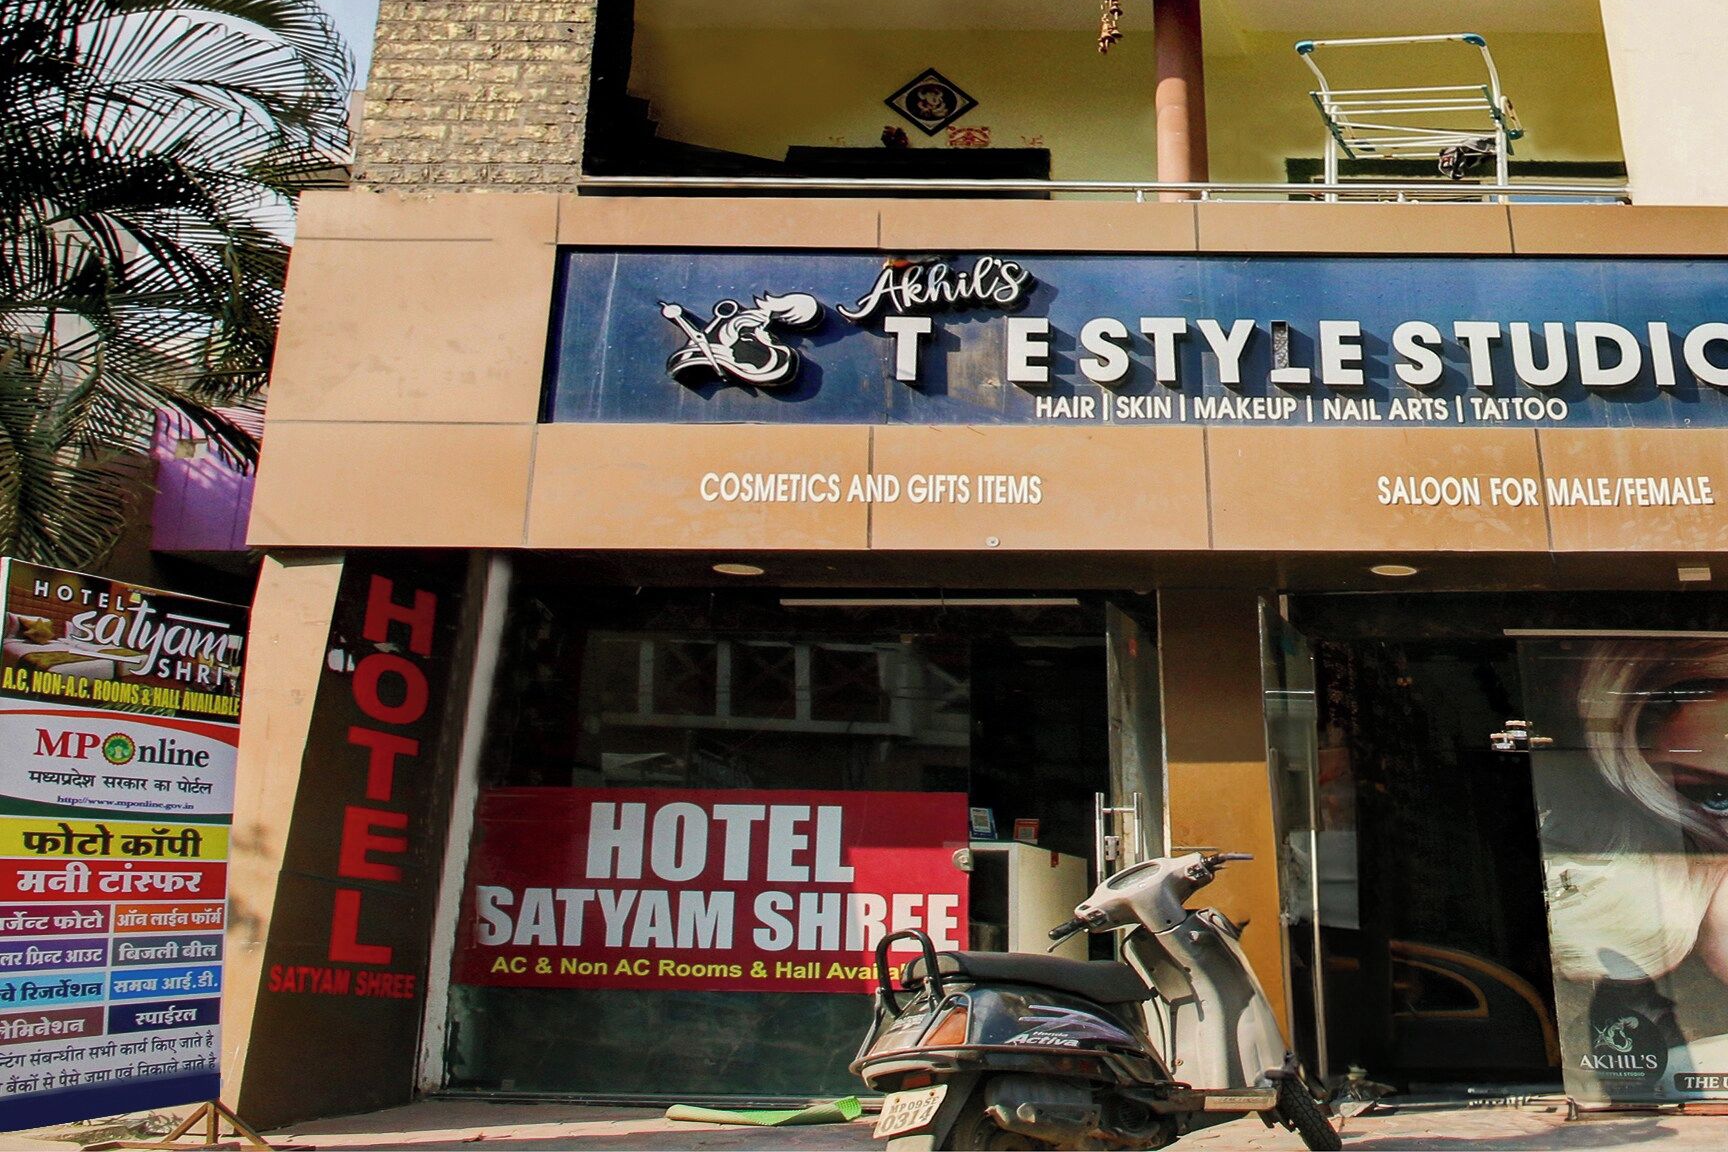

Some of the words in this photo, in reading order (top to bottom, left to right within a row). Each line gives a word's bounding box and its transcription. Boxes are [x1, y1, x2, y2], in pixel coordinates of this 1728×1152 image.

[837, 256, 1029, 319] Akhil's
[1035, 396, 1095, 420] HAIR
[1115, 396, 1172, 420] SKIN
[1192, 397, 1298, 422] MAKEUP
[1323, 397, 1382, 422] NAIL
[1388, 397, 1449, 422] ARTS
[1470, 397, 1569, 422] TATTOO
[700, 472, 840, 504] COSMETICS
[846, 474, 900, 505] AND
[907, 474, 971, 505] GIFTS
[977, 474, 1042, 505] ITEMS
[1377, 476, 1482, 507] SALOON
[1490, 476, 1537, 507] FOR
[1546, 476, 1714, 507] MALE/FEMALE
[34, 580, 125, 612] HOTEL
[71, 599, 229, 676] satyam
[157, 658, 224, 686] SHRI
[93, 679, 139, 705] ROOMS
[141, 688, 151, 706] &
[153, 687, 181, 710] HALL
[181, 690, 240, 716] AVAILABLE
[28, 768, 96, 788] मध्यप्रदेश
[102, 775, 148, 791] सरकार
[154, 779, 172, 792] का
[176, 776, 213, 795] पोर्टल
[328, 573, 438, 966] HOTEL
[22, 822, 114, 855] फोटो
[121, 827, 203, 857] कॉपी
[585, 801, 855, 884] HOTEL
[16, 861, 92, 893] मनी
[54, 909, 104, 929] फोटो
[117, 909, 148, 927] ऑन
[150, 908, 189, 927] लाईन
[191, 907, 223, 925] फॉर्म
[475, 885, 735, 951] SATYAM
[752, 890, 960, 954] SHREE
[0, 952, 23, 966] लर
[25, 945, 62, 966] प्रिन्ट
[65, 948, 104, 963] आउट
[118, 941, 179, 961] बिजली
[182, 940, 218, 958] बील
[268, 963, 350, 995] SATYAM
[354, 969, 416, 1000] SHREE
[491, 956, 531, 975] AC
[534, 957, 552, 975] &
[559, 957, 608, 977] Non
[614, 958, 651, 977] AC
[658, 959, 742, 979] Rooms
[750, 960, 769, 979] &
[775, 960, 821, 980] Hall
[20, 979, 104, 1001] रिजर्वेशन
[135, 1005, 198, 1025] स्पाईरल
[88, 1040, 118, 1060] सभी
[120, 1037, 148, 1055] कार्य
[151, 1036, 177, 1053] किए
[179, 1032, 203, 1049] जाते
[1005, 1033, 1080, 1048] Activa
[6, 1073, 40, 1093] बैंकों
[43, 1071, 55, 1090] से
[59, 1068, 81, 1087] पैसे
[85, 1069, 112, 1084] जमा
[115, 1063, 134, 1079] एवं
[137, 1057, 179, 1077] निकाले
[182, 1054, 206, 1071] जाते
[1580, 1054, 1658, 1069] AKHIL'S
[1684, 1076, 1720, 1089] THE
[881, 1106, 934, 1133] 0314
